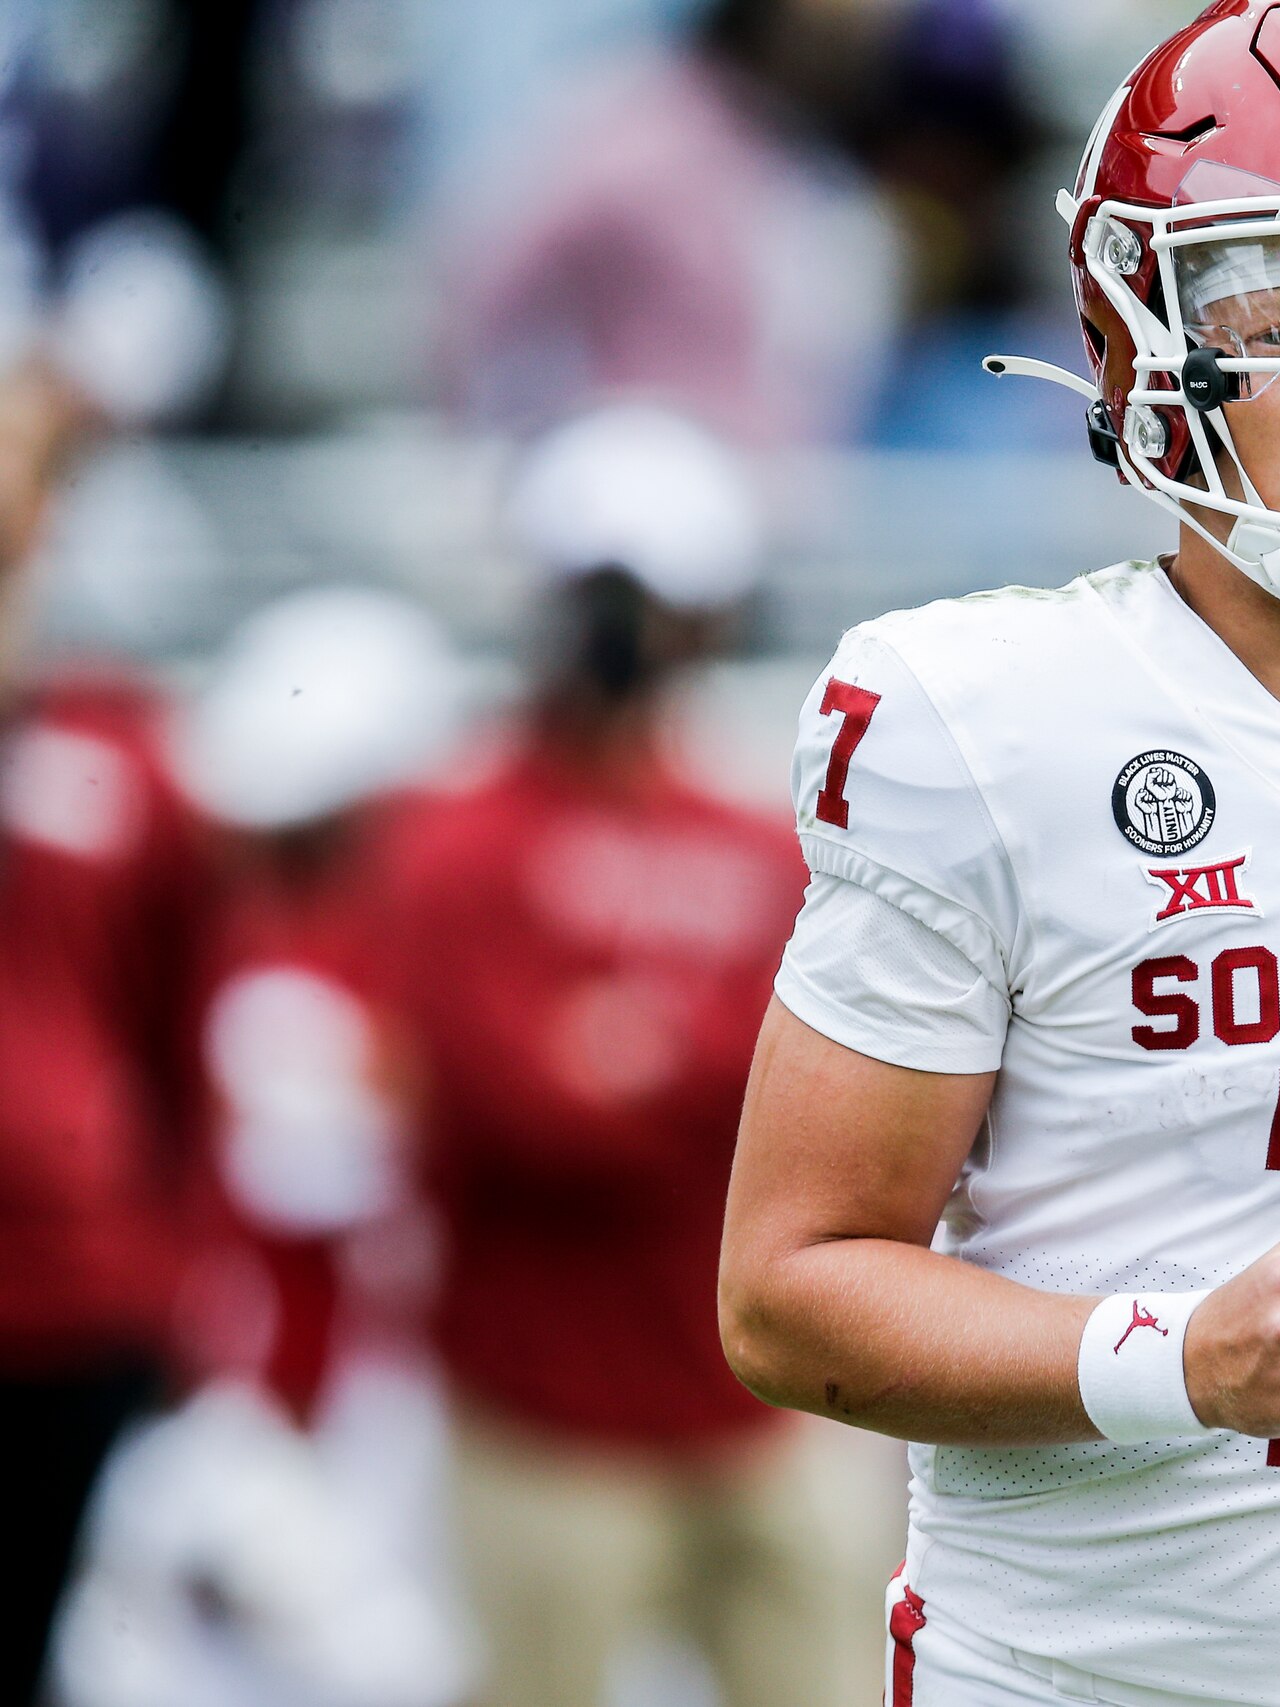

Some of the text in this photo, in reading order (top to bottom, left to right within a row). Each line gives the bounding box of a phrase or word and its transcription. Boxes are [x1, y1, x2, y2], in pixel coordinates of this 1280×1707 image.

[815, 675, 882, 830] 7
[1118, 752, 1200, 787] BLACK LIVES MATTER
[1124, 806, 1214, 854] SOONERS FOR HUMANITY
[1163, 807, 1178, 840] UNITY
[1148, 855, 1254, 922] XII
